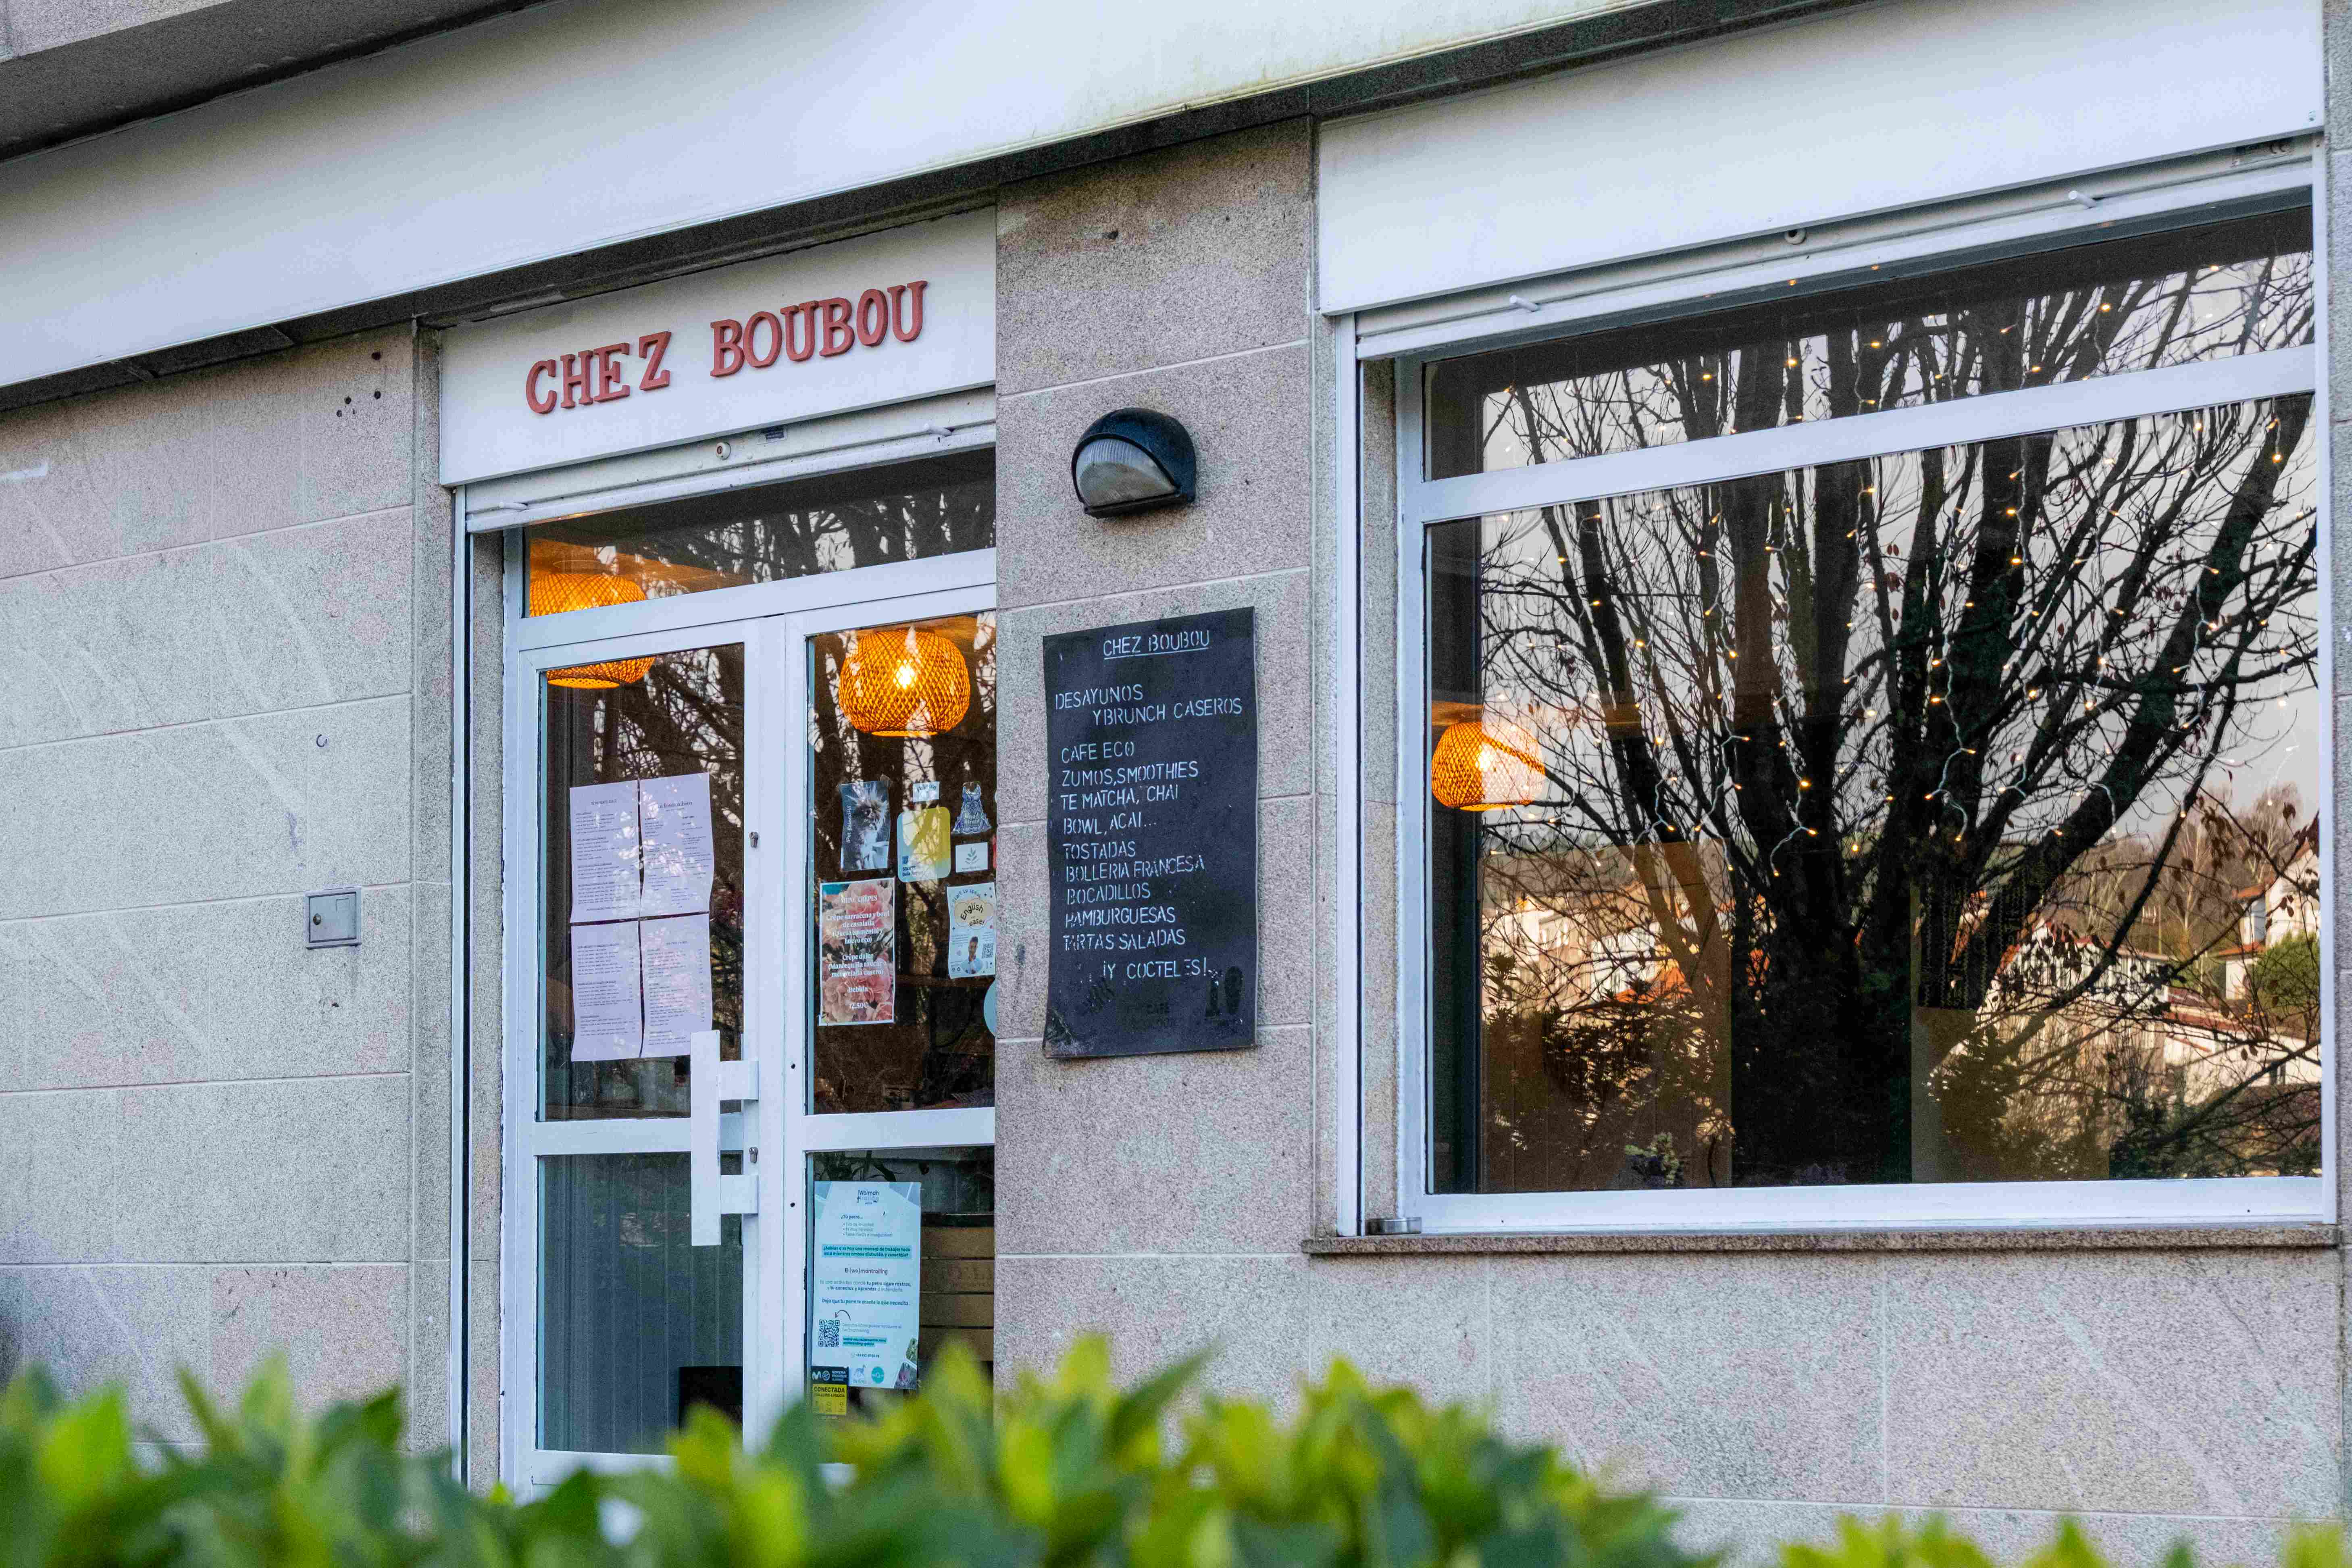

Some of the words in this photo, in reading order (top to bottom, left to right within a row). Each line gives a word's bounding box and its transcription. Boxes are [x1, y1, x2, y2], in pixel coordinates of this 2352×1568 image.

[526, 331, 671, 414] CHEZ
[710, 280, 928, 377] BOUBOU
[1103, 636, 1142, 656] CHEZ
[1148, 630, 1209, 652] BOUBOU
[1055, 684, 1143, 710] DESAYUNOS
[1174, 698, 1242, 719] CASEROS
[1062, 743, 1097, 763] CAFE
[1103, 741, 1134, 758] ECO
[1060, 794, 1077, 810] TE
[1082, 788, 1139, 809] MATCHA,
[1147, 785, 1178, 802] CHAI
[1064, 818, 1107, 836] BOWL,
[1063, 841, 1136, 860] TOSTADAS
[1066, 862, 1129, 882] BOLLERIA
[1134, 855, 1205, 879] FRANCESA
[1067, 882, 1151, 905] BOCADILLOS
[960, 903, 983, 920] English
[1065, 906, 1176, 928] HAMBURGUESAS
[1063, 934, 1114, 952] TARTAS
[1118, 929, 1186, 951] SALADAS
